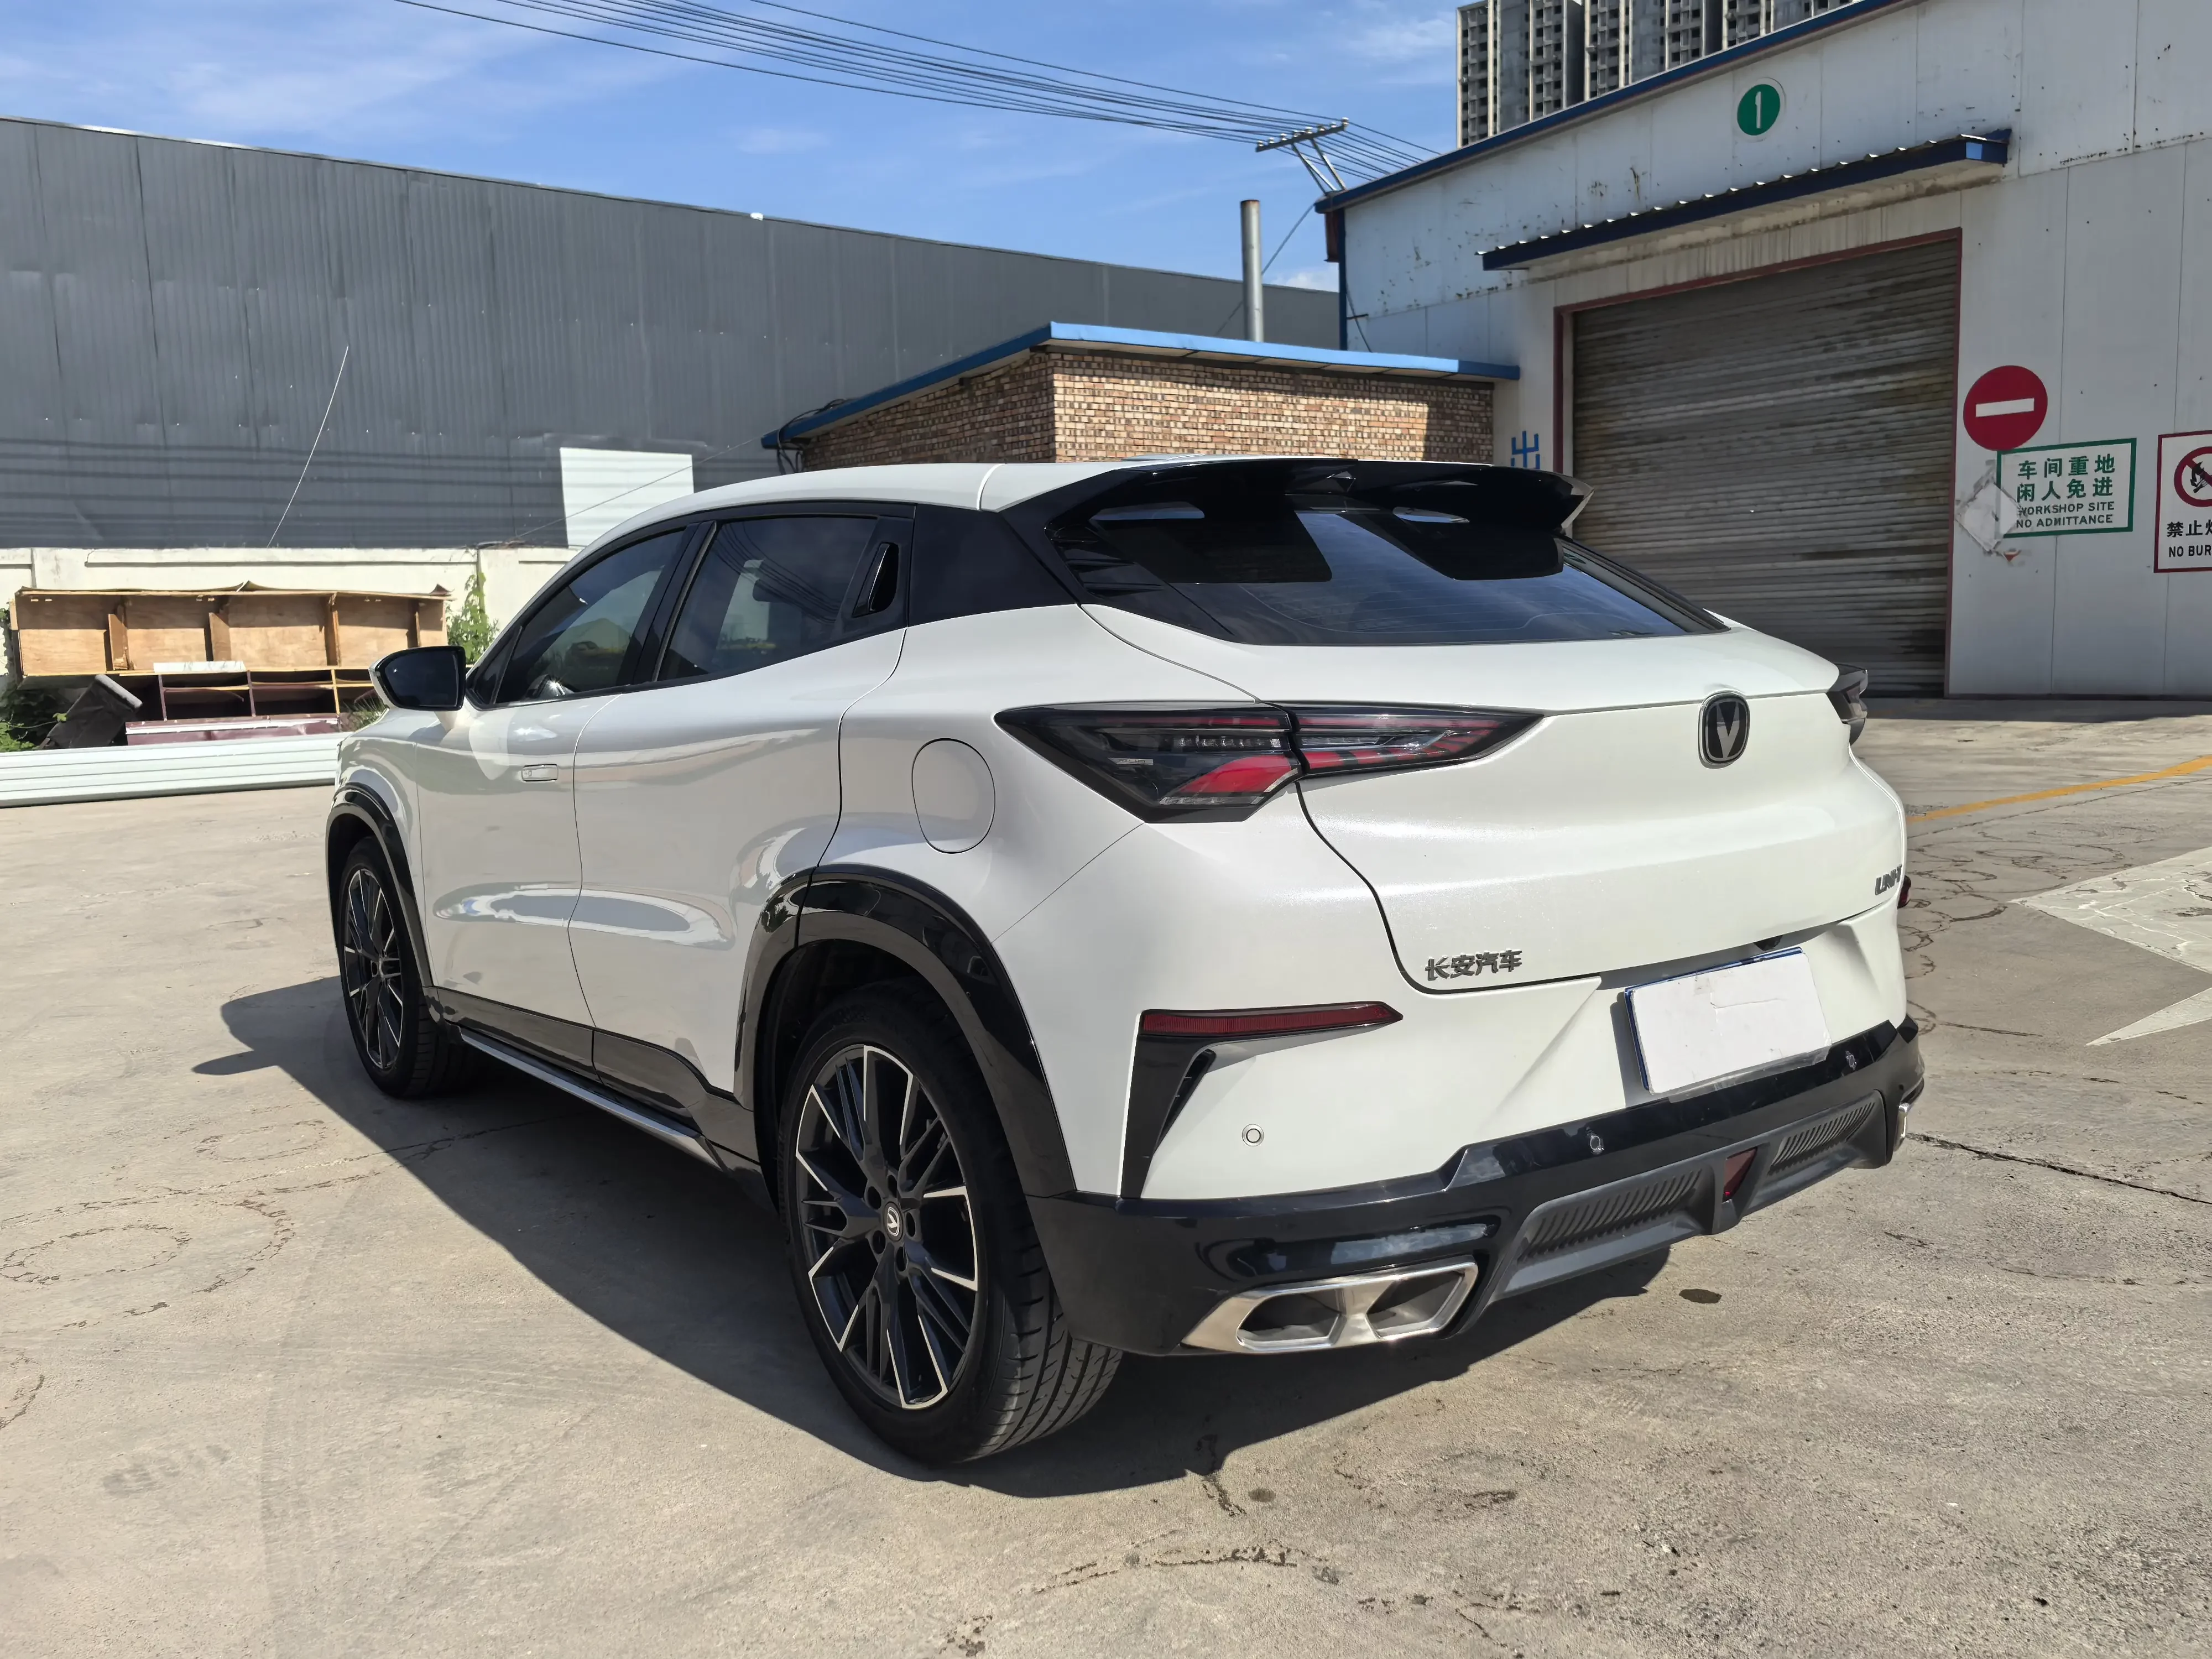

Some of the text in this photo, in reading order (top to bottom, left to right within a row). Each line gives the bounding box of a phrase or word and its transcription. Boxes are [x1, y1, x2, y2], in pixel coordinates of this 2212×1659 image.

[1755, 91, 1762, 129] 1
[2017, 453, 2115, 480] 车间重地
[2016, 476, 2114, 503] 闲人免进
[2016, 514, 2113, 529] NO ADMITTANCE
[2018, 501, 2115, 517] WORKSHOP SITE
[2168, 546, 2184, 557] NO
[1425, 948, 1522, 981] 长安汽车
